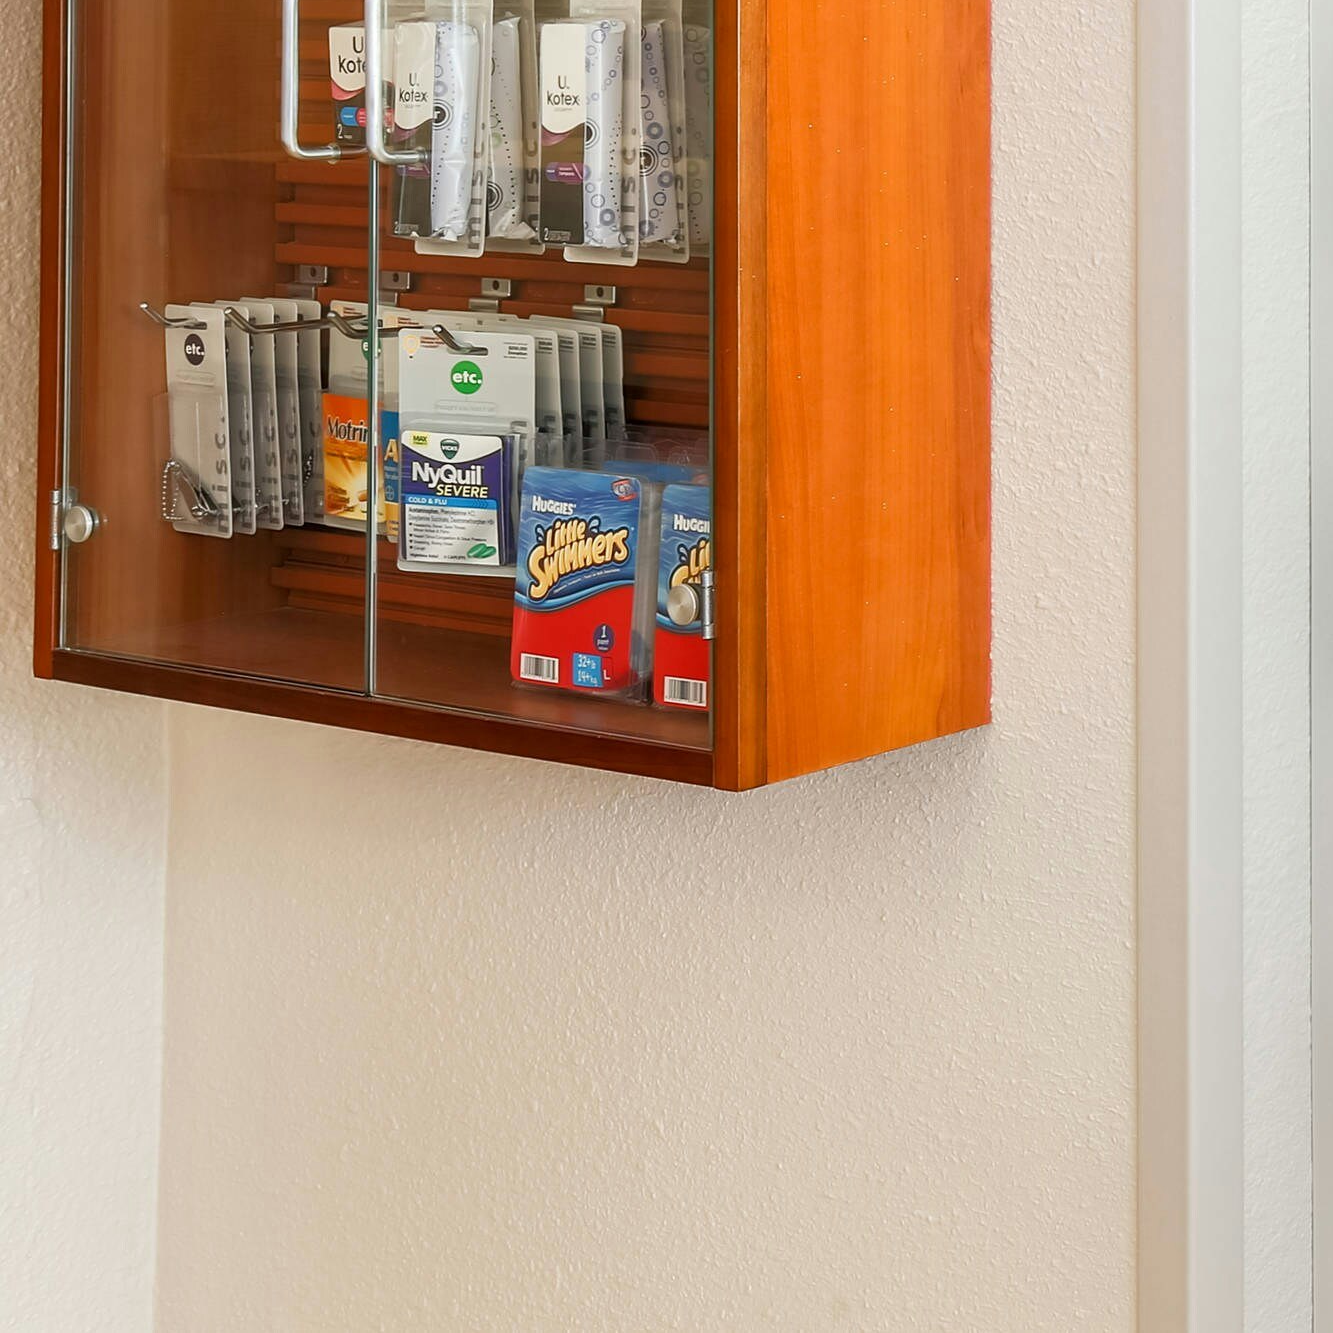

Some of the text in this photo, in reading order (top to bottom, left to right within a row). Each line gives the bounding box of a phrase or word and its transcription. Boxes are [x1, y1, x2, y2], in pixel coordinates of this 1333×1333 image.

[398, 88, 429, 103] kotex
[546, 90, 580, 107] kotex
[185, 343, 206, 357] etc.
[452, 370, 483, 385] etc.
[411, 461, 483, 489] NyQuil
[436, 484, 489, 499] SEVERE
[408, 496, 428, 504] COLD
[532, 494, 575, 516] HUGGIES
[545, 517, 587, 555] Little
[601, 625, 608, 639] 1
[602, 668, 612, 681] L
